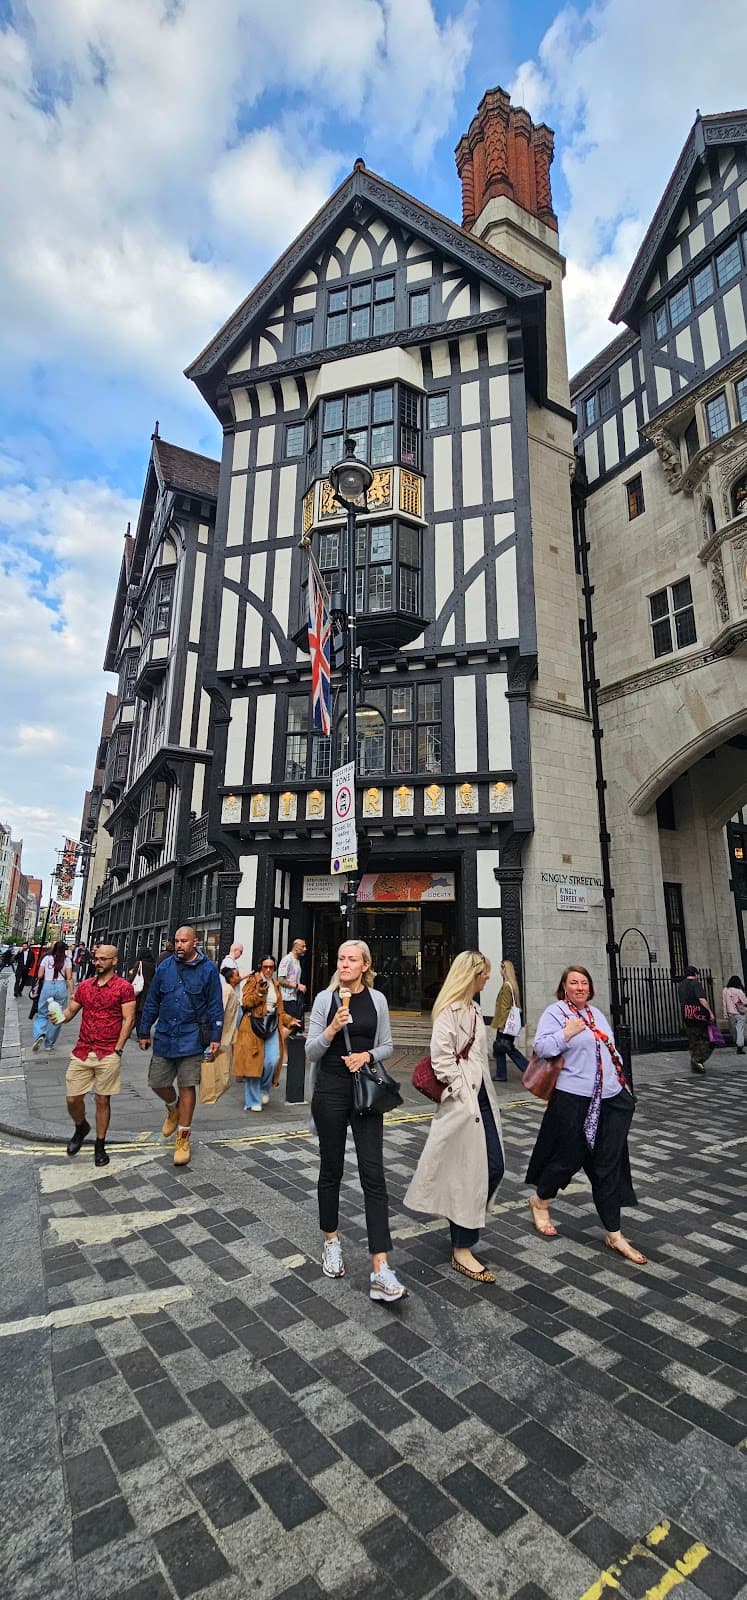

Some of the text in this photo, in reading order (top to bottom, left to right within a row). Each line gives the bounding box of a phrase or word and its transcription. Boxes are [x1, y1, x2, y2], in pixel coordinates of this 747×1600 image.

[336, 773, 351, 787] ZONE
[252, 785, 443, 817] LIBRTY
[541, 872, 568, 884] KINGLY
[568, 875, 593, 886] STREET
[560, 887, 577, 895] KINGLY
[560, 895, 577, 903] STREET
